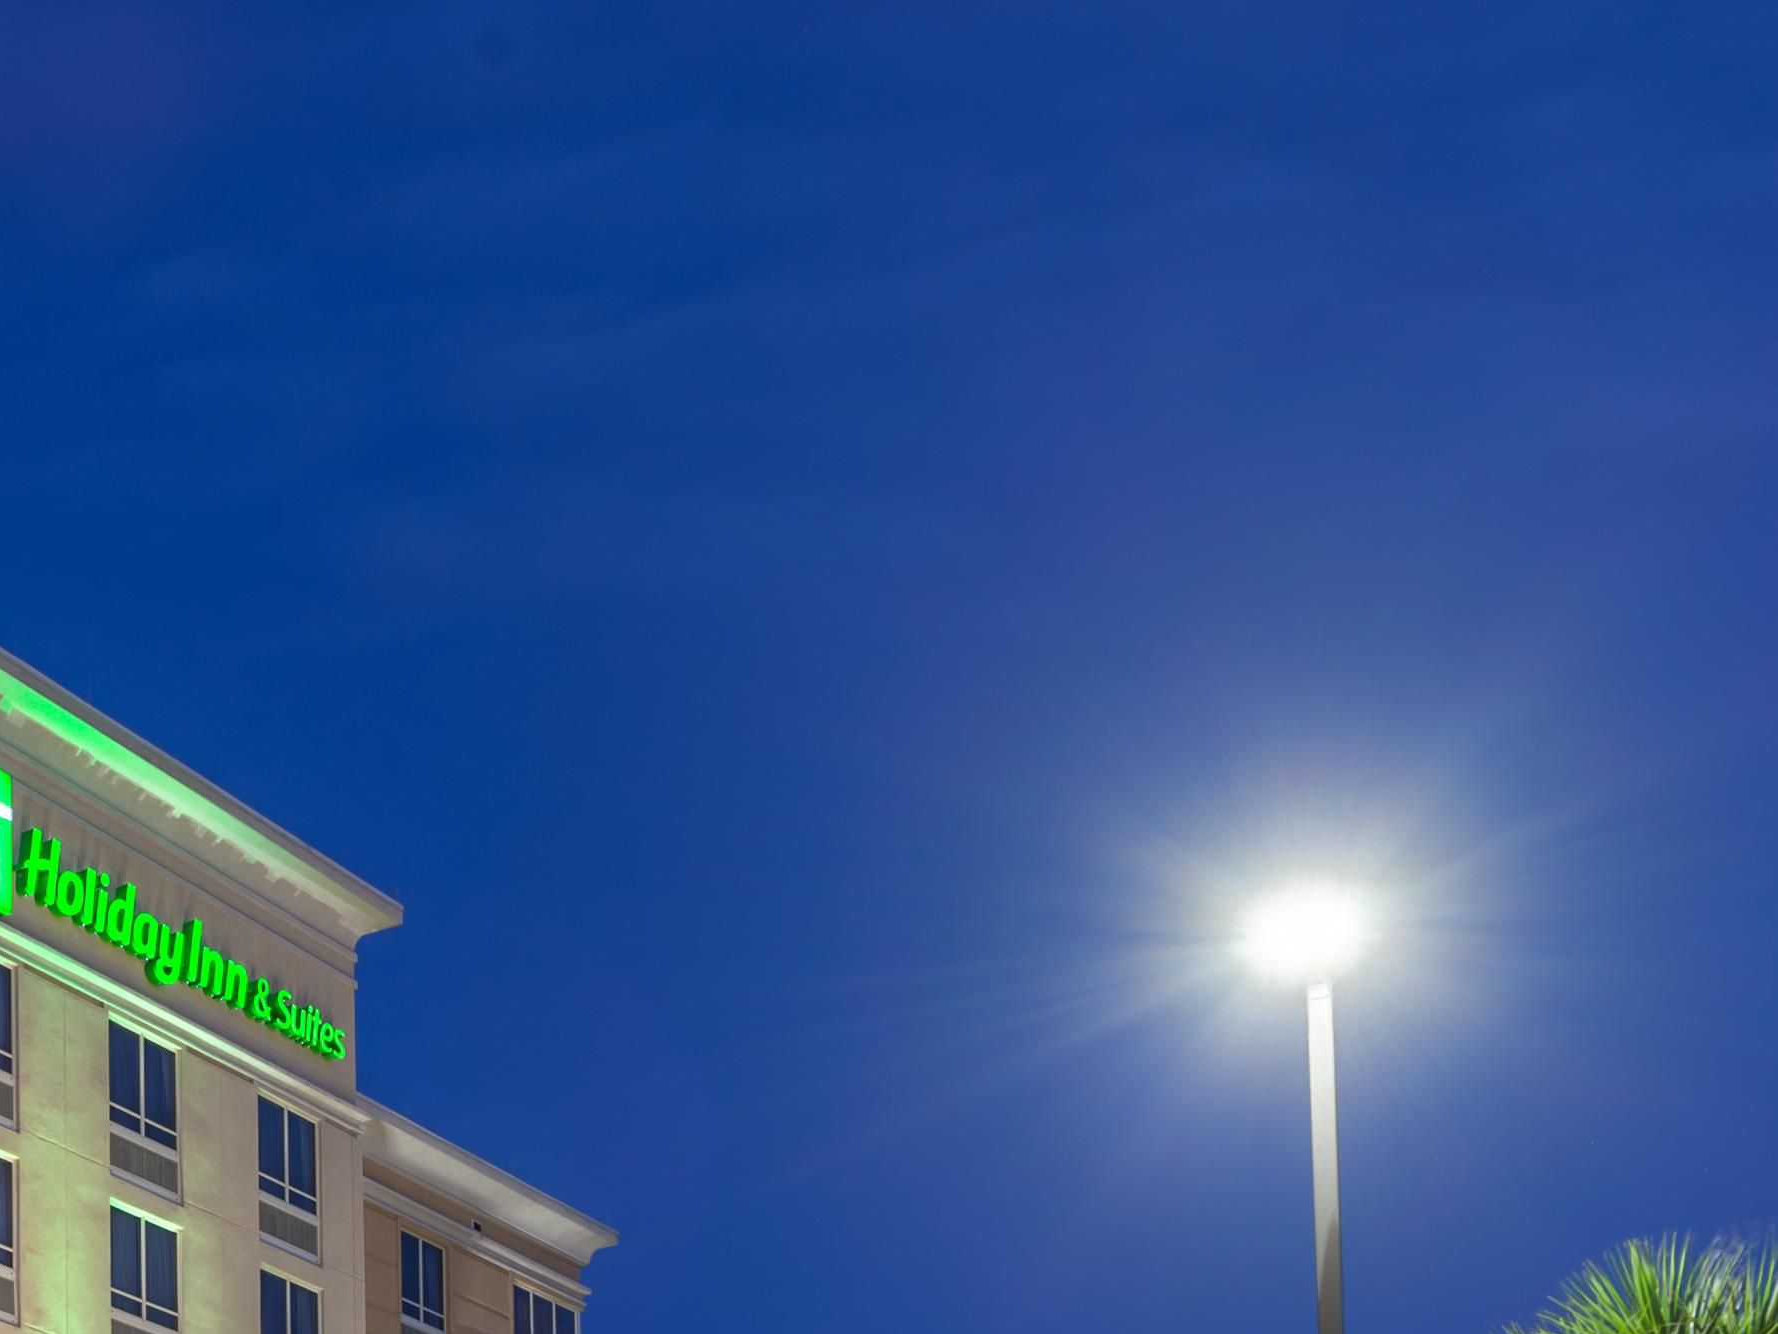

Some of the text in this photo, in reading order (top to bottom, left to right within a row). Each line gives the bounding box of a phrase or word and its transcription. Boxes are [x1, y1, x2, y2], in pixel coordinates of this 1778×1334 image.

[20, 827, 346, 1060] Holiday Inn & Suites
